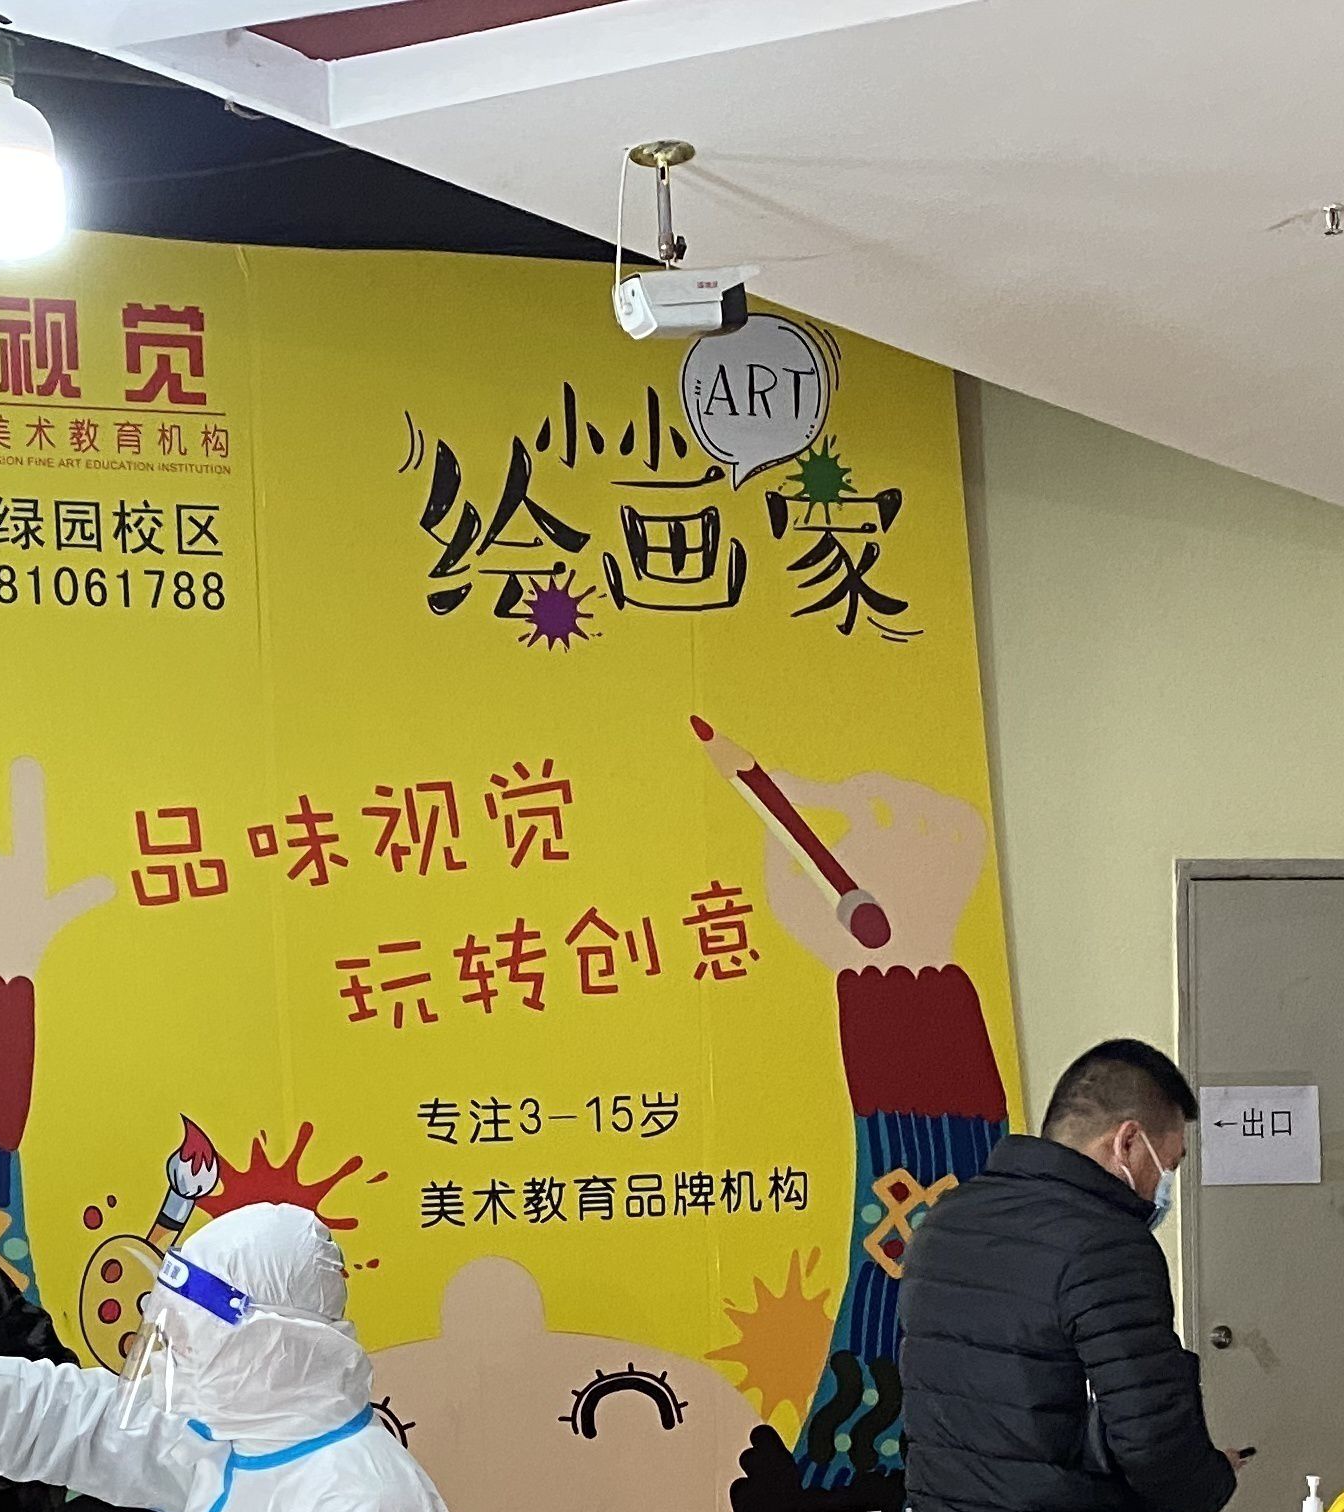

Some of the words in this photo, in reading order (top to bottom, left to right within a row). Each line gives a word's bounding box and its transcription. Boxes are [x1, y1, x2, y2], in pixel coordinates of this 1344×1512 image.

[703, 363, 815, 420] ART
[535, 381, 688, 472] 小小
[27, 456, 55, 468] FINE
[57, 457, 82, 469] ART
[85, 459, 155, 472] EDUCATION
[157, 462, 232, 475] INSTITUTION
[130, 757, 574, 908] 品味视觉
[334, 880, 761, 1030] 玩转创意
[1239, 1105, 1294, 1140] 出口
[419, 1164, 810, 1230] 美术教育品牌机构
